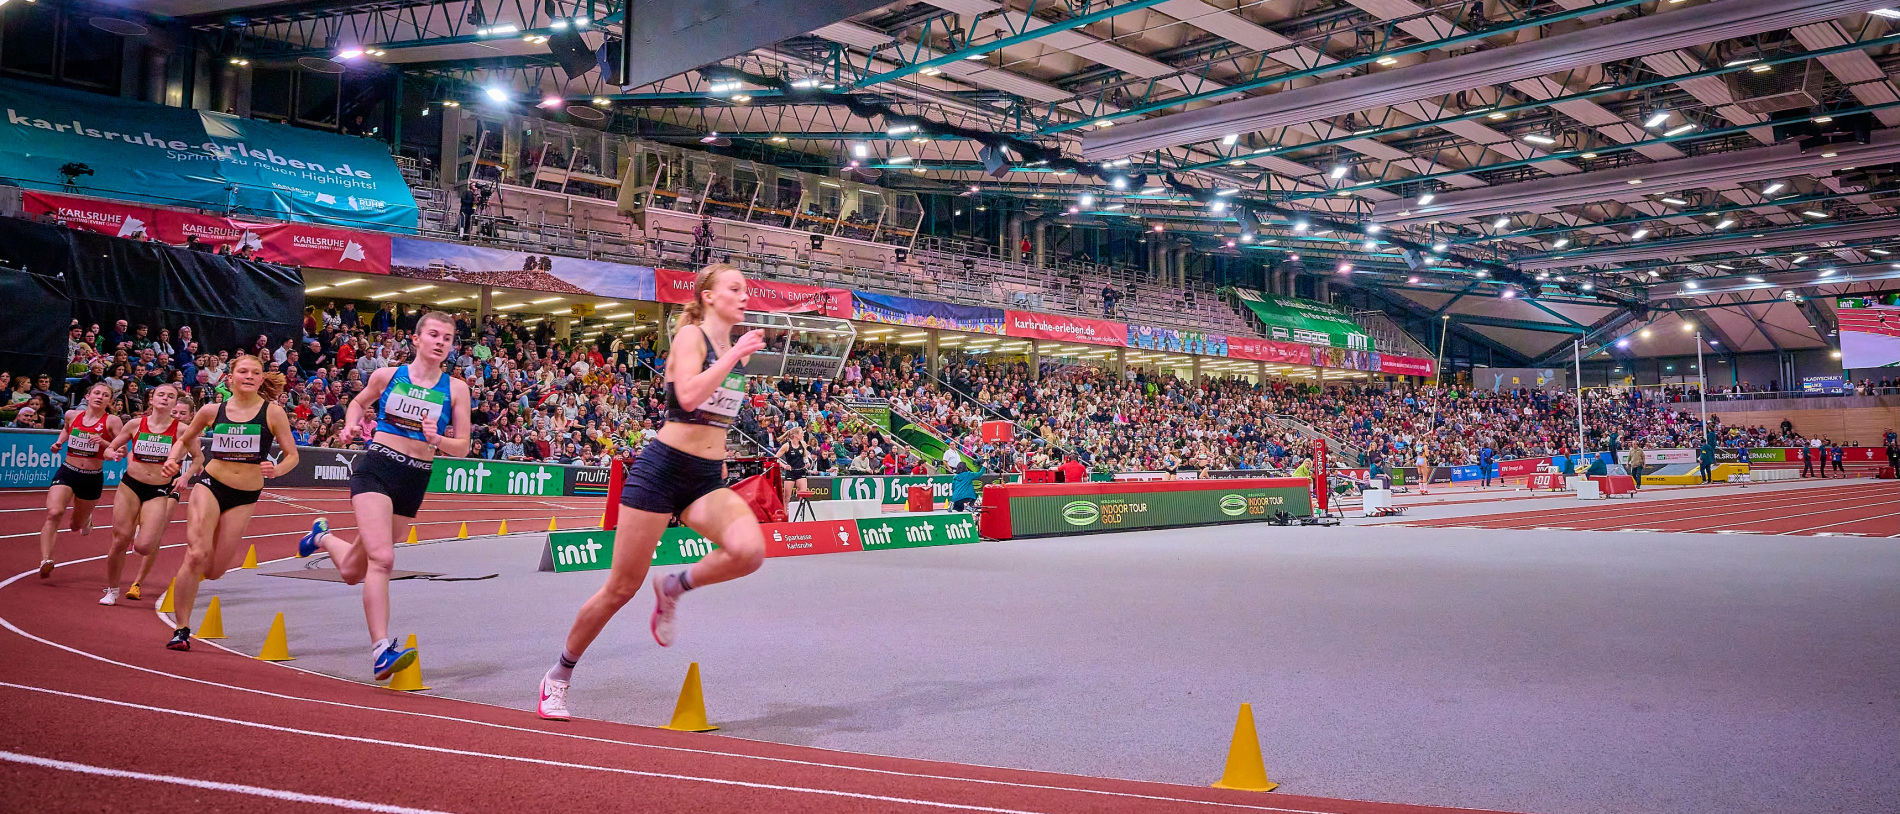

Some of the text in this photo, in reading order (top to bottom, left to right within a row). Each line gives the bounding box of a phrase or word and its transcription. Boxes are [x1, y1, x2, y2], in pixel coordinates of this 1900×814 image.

[7, 109, 373, 180] karlsruhe-erleben.de
[231, 158, 248, 166] zu
[302, 171, 377, 190] Highlights!
[58, 207, 122, 224] KARLSRUHE
[182, 223, 240, 237] KARLSRUHE
[293, 235, 345, 248] KARLSRUHE
[748, 286, 777, 299] VENTS
[1840, 299, 1855, 308] init
[571, 307, 579, 315] 31
[1015, 317, 1095, 335] karlsruhe-erleben.de
[787, 359, 837, 369] EUROPAHALLE
[785, 366, 827, 376] KARLSRUHE
[408, 388, 430, 399] init
[395, 399, 430, 421] Jung
[227, 425, 247, 434] init
[71, 438, 95, 449] Brand
[136, 443, 169, 454] Rohrbach
[219, 437, 253, 448] Micol
[1, 444, 62, 468] rleben
[379, 447, 407, 463] PRO
[407, 459, 432, 470] NIKE
[1577, 457, 1591, 465] RN
[5, 470, 50, 484] Highlights!
[314, 465, 347, 480] PUMA
[446, 463, 491, 493] init
[508, 466, 552, 495] init
[812, 487, 829, 495] GOLD
[1101, 502, 1148, 514] INDOOR TOUR
[1248, 497, 1284, 506] INDOOR TOUR
[1249, 506, 1265, 515] GOLD
[1101, 514, 1122, 524] GOLD
[863, 522, 894, 546] init
[905, 520, 935, 543] init
[945, 518, 974, 540] init
[784, 534, 812, 542] Sparkasse
[557, 538, 602, 566] init
[677, 537, 713, 558] init
